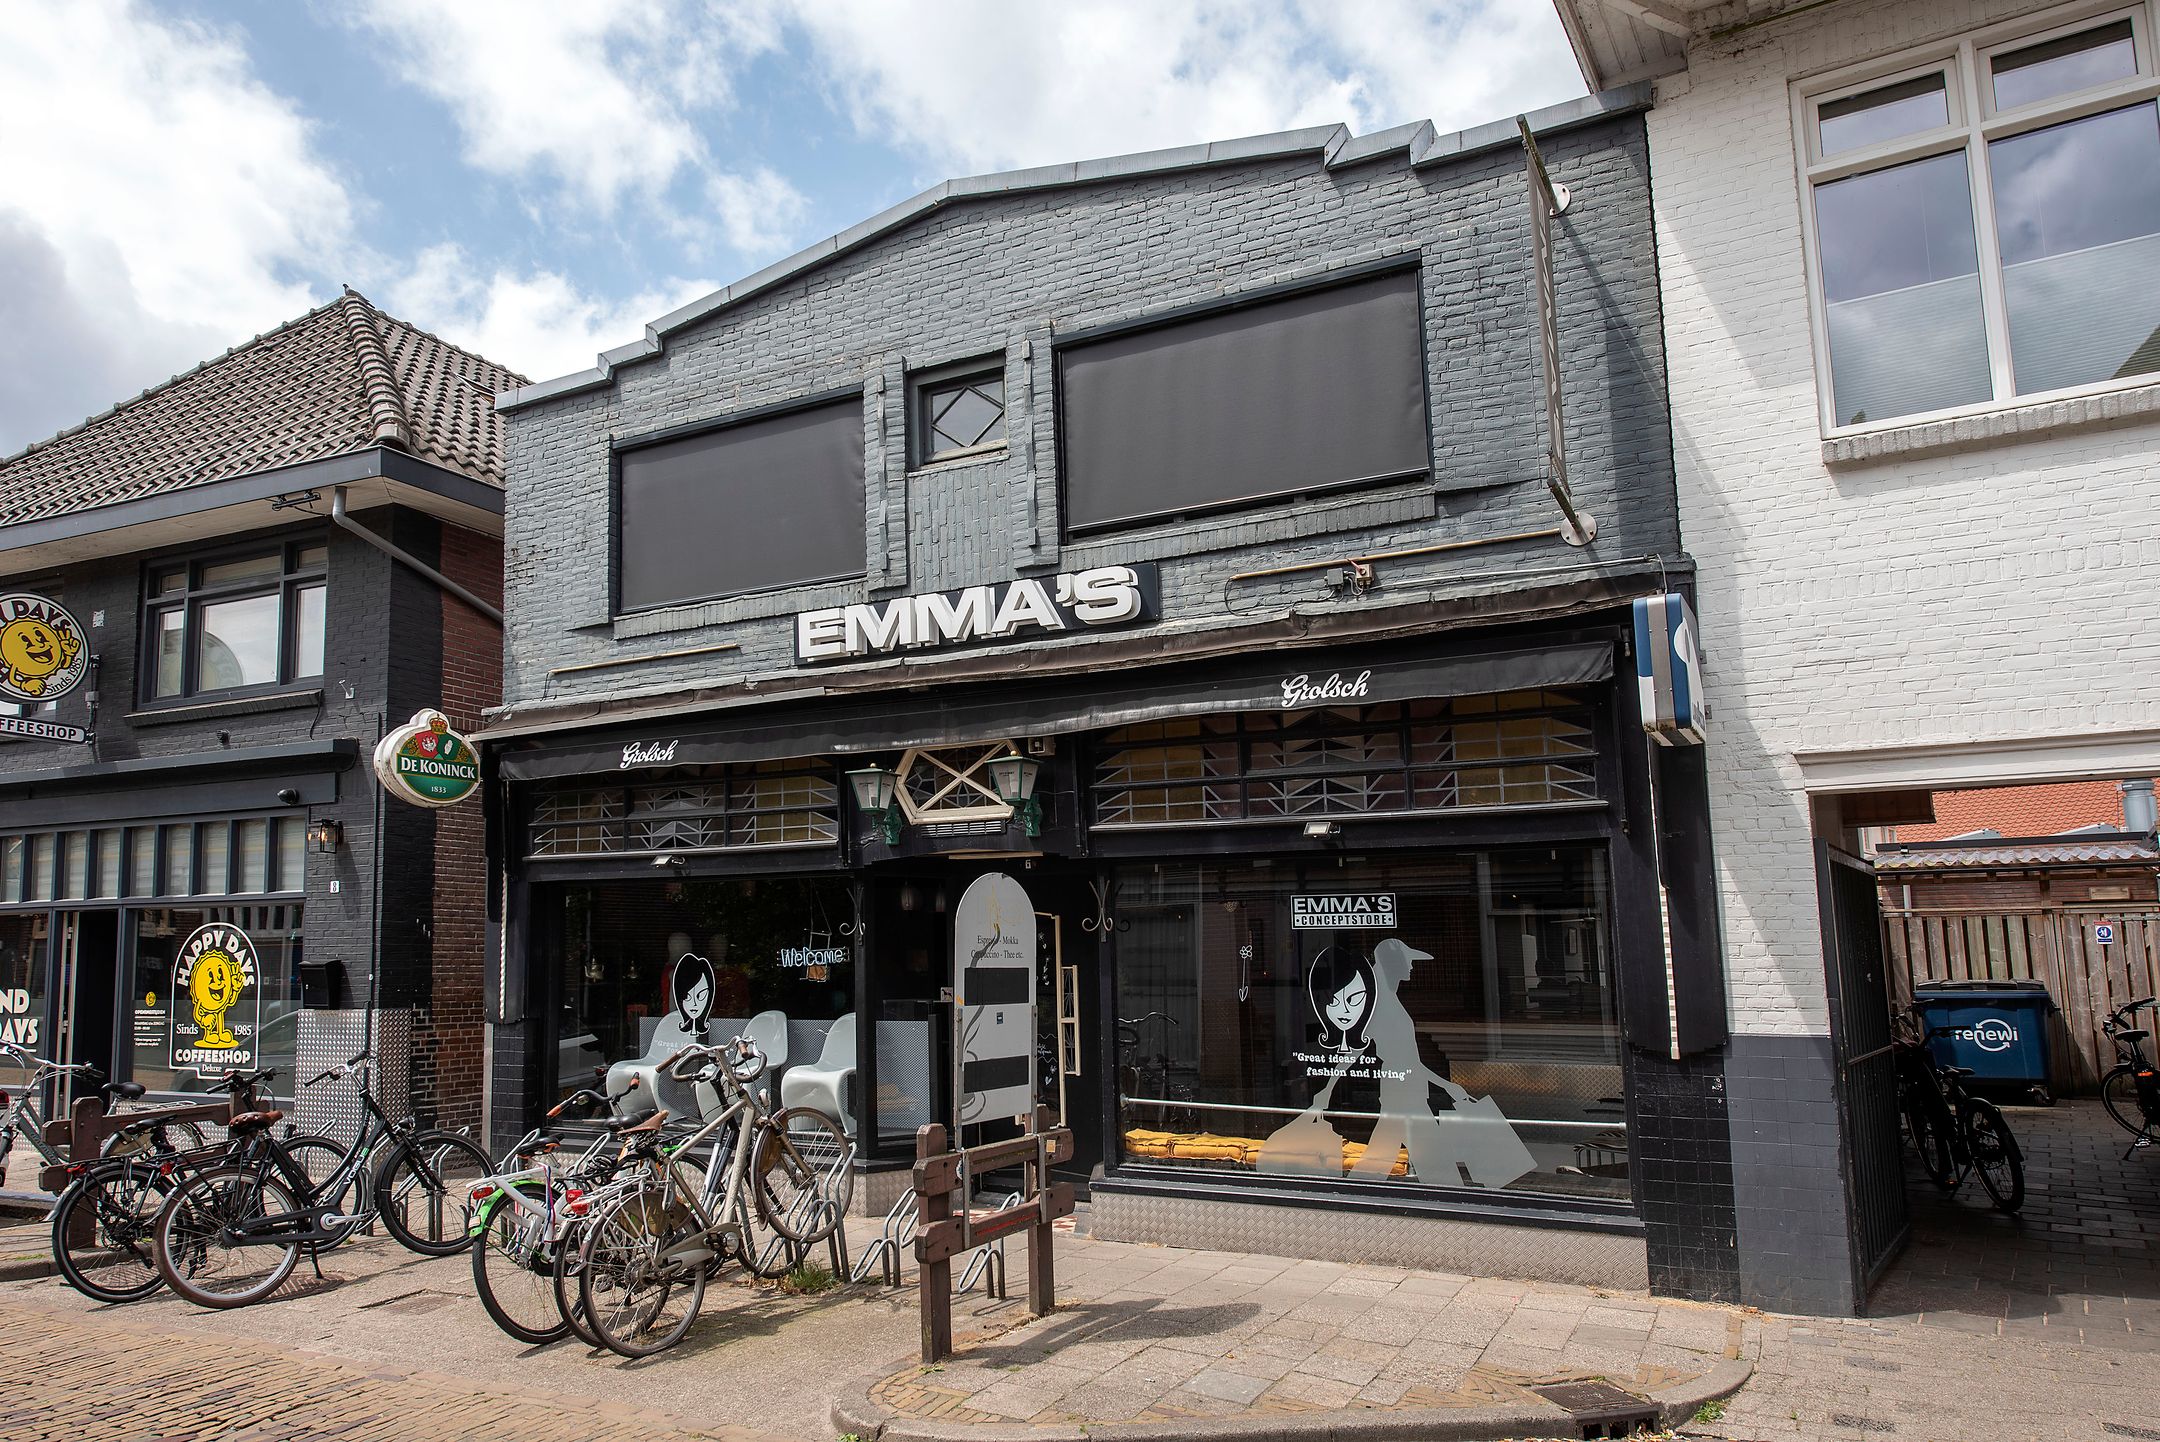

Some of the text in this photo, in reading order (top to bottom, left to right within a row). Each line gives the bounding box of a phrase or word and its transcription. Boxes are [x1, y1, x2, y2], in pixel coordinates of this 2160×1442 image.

[11, 600, 72, 637] DAYS
[798, 566, 1141, 661] EMMA'S
[46, 657, 83, 694] Sinds 1985
[1281, 670, 1371, 707] Grolsch
[620, 740, 678, 768] Grolsch
[401, 757, 475, 779] DE KONINCK
[1294, 896, 1393, 913] EMMA'S
[1301, 915, 1387, 926] CONCEPTSTORE
[177, 930, 255, 987] HAPPY DAYS
[781, 947, 844, 967] Welcome
[0, 1018, 39, 1043] AYS
[176, 1024, 251, 1036] Sinds 1985
[1954, 1027, 2018, 1041] renewi
[175, 1049, 251, 1064] COFFEESHOP
[1328, 1054, 1356, 1064] ideas
[1359, 1055, 1376, 1064] for
[1306, 1067, 1347, 1077] fashion
[1350, 1069, 1370, 1078] and
[343, 1147, 370, 1185] VOGUE
